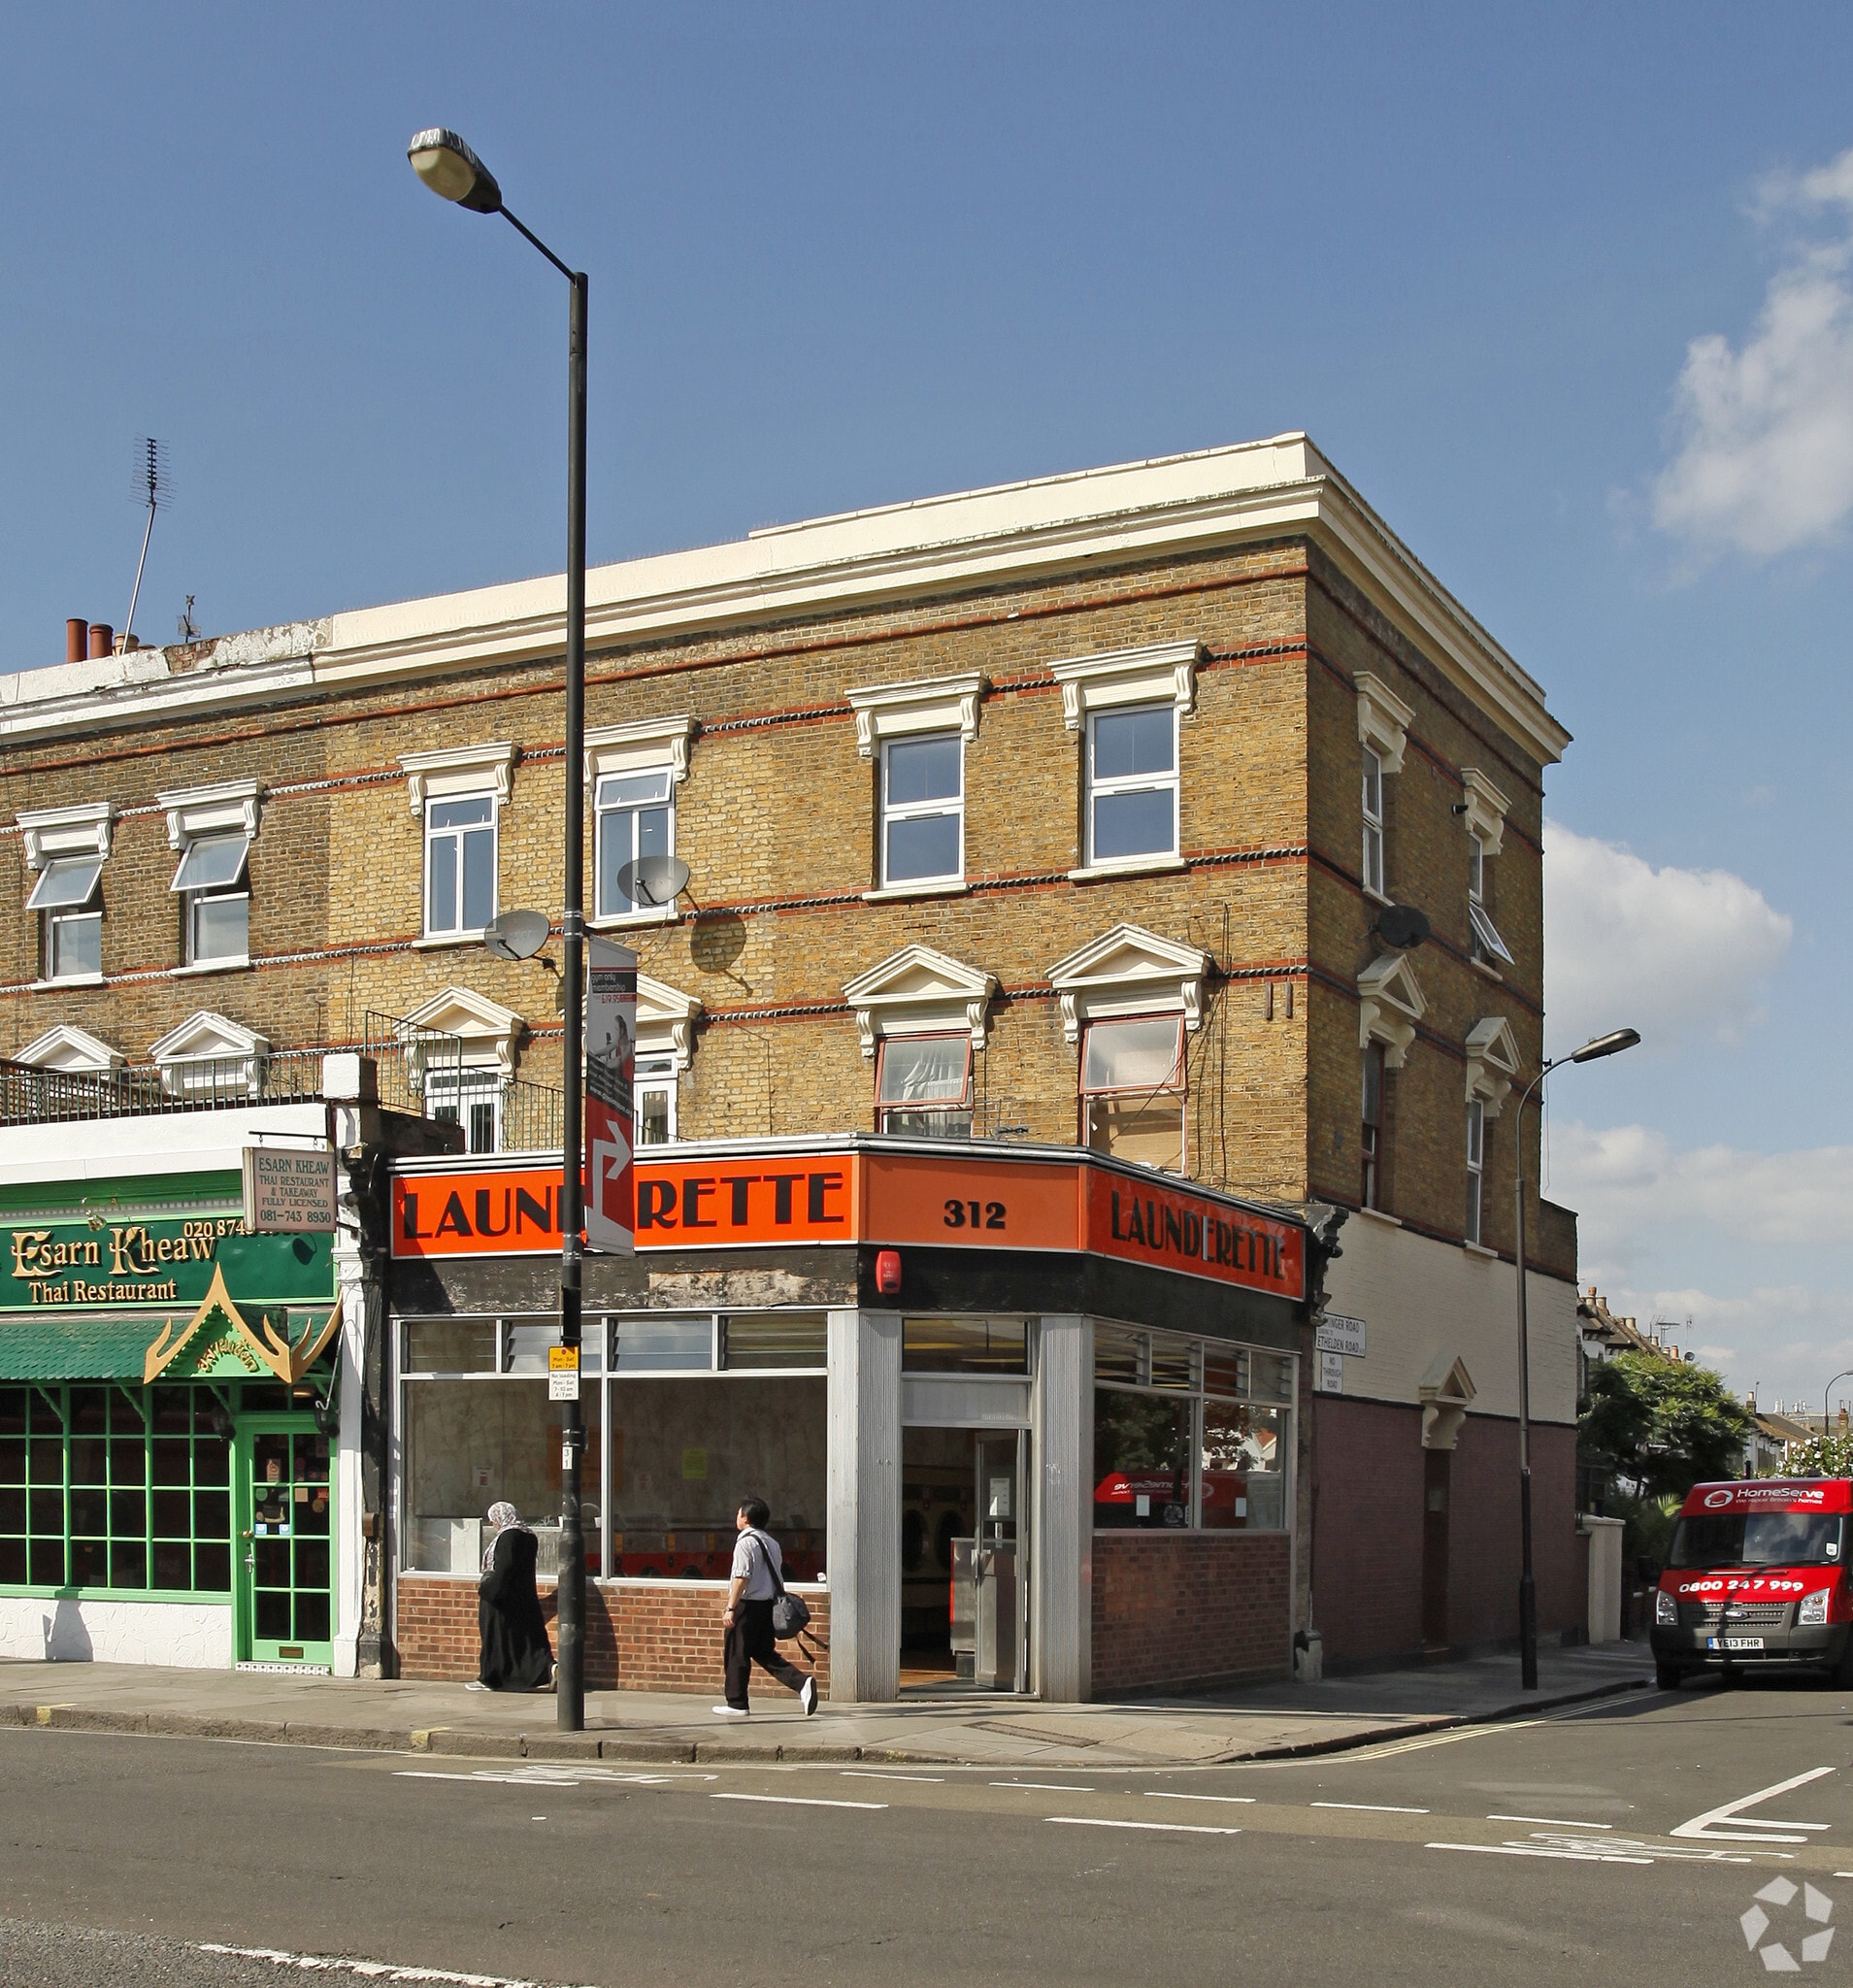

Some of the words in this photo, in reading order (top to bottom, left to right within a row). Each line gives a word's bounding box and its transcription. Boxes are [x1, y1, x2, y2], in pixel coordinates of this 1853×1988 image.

[258, 1157, 292, 1173] ESARN
[295, 1159, 330, 1175] KHEAW
[259, 1175, 278, 1185] THAI
[281, 1176, 330, 1188] RESTAURANT
[271, 1186, 277, 1197] &
[280, 1186, 318, 1199] TAKEAWAY
[262, 1197, 286, 1207] FULLY
[289, 1198, 329, 1209] LICENSED
[403, 1172, 844, 1240] LAUNRETTE
[260, 1209, 303, 1223] 081-743
[307, 1210, 331, 1224] 8930
[943, 1199, 1006, 1229] 312
[182, 1221, 214, 1238] 020
[216, 1218, 255, 1235] 874
[1111, 1190, 1285, 1279] LAUNDERETTE
[11, 1230, 100, 1277] Esarn
[109, 1226, 216, 1275] Kheaw
[28, 1280, 69, 1304] Thai
[73, 1277, 178, 1302] Restaurant
[1345, 1340, 1359, 1353] ROAD
[564, 1448, 570, 1457] 3
[1737, 1487, 1825, 1499] HomeServe
[1678, 1580, 1723, 1593] 0800
[1727, 1579, 1765, 1590] 247
[1769, 1579, 1804, 1592] 999
[1717, 1639, 1738, 1647] YE13
[1740, 1639, 1760, 1647] FHR
